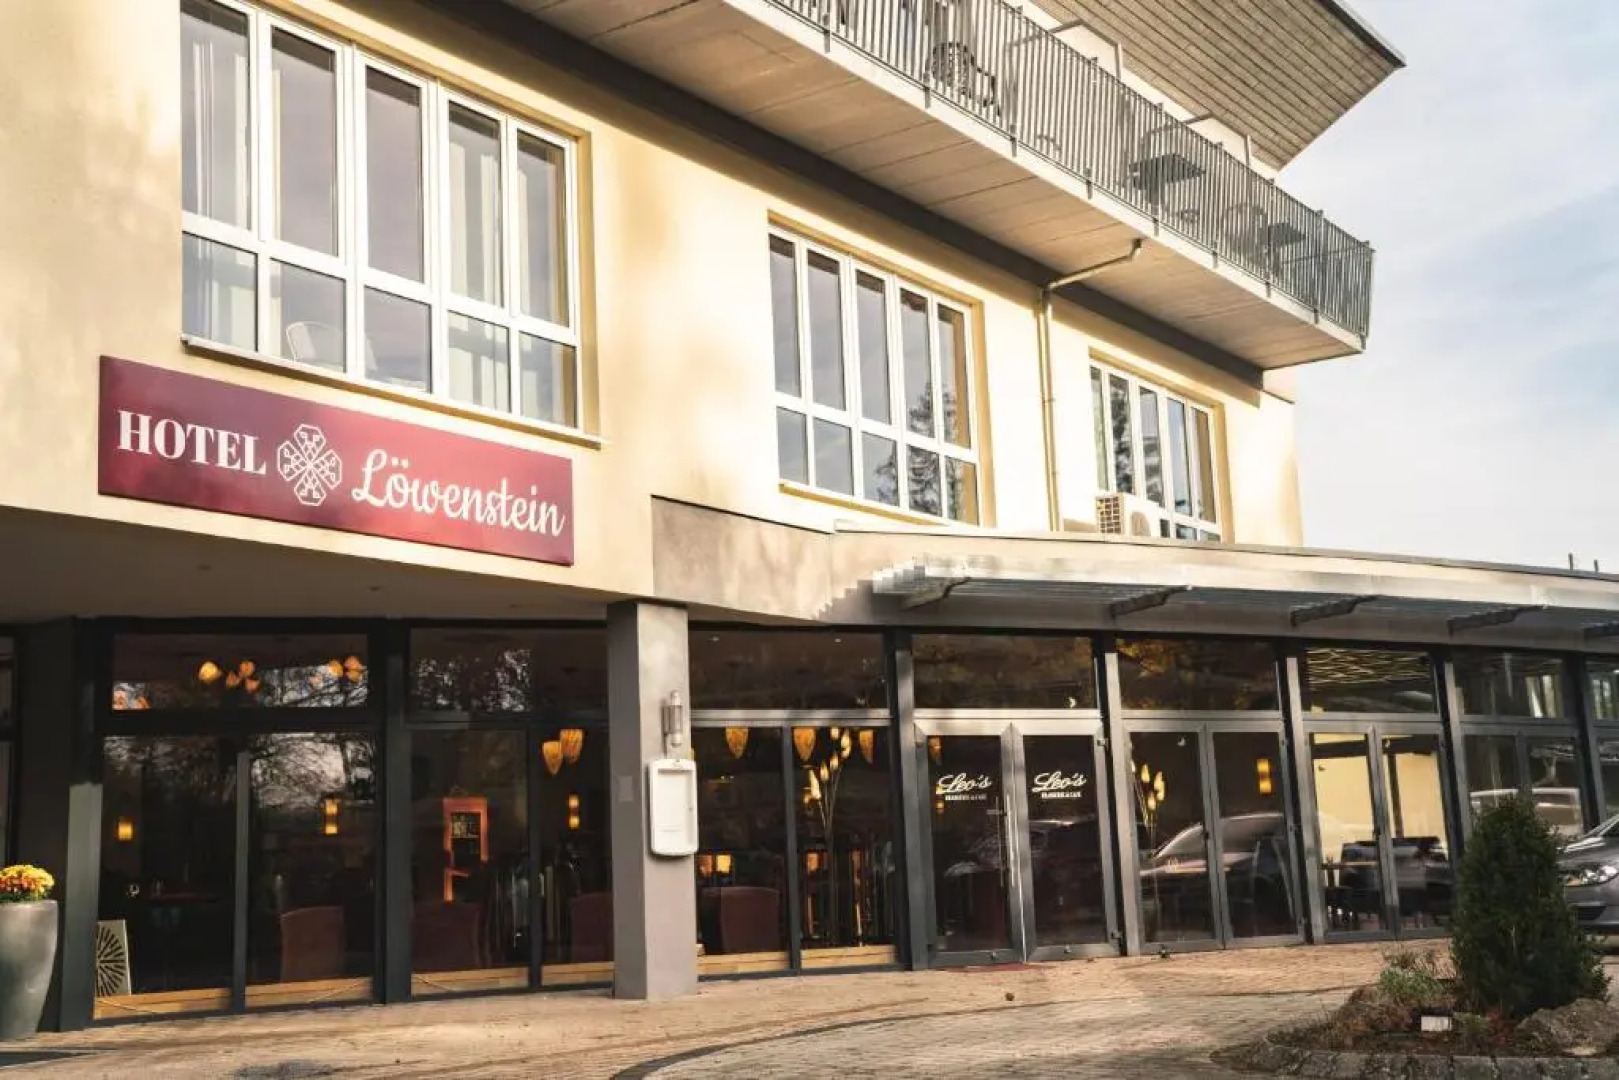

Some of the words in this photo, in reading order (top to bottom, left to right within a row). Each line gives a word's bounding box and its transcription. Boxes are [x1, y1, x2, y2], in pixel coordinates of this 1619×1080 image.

[117, 410, 266, 475] HOTEL
[352, 448, 565, 537] Löwenstein
[936, 772, 992, 794] Leo's
[1031, 771, 1087, 793] Leo's
